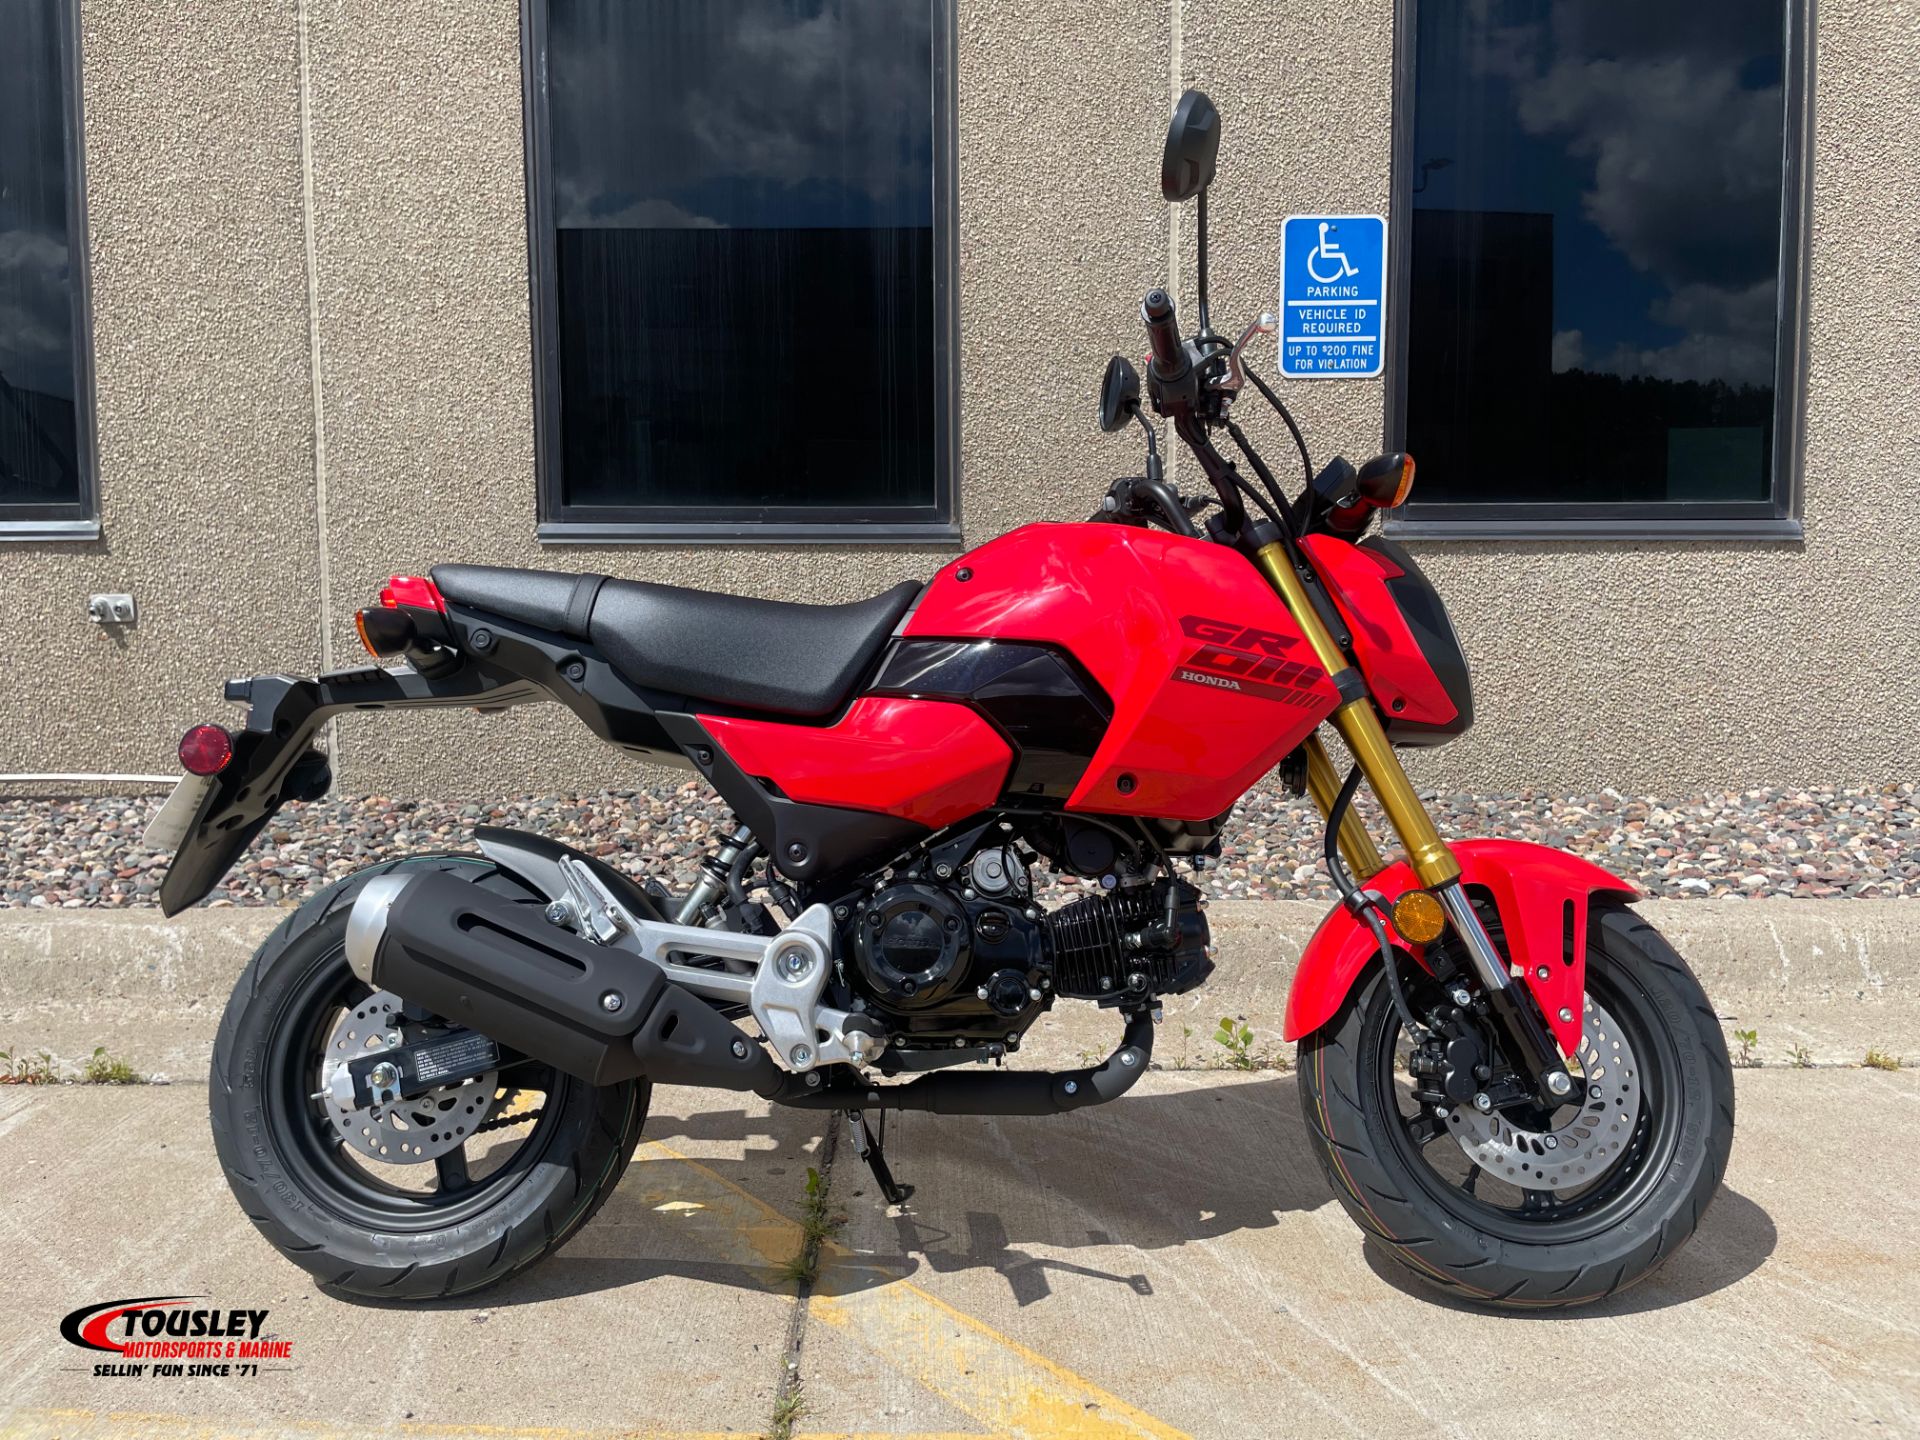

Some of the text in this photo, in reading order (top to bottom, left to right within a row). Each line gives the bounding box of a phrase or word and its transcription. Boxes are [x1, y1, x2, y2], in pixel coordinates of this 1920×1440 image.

[1307, 286, 1359, 297] PARKING
[1299, 309, 1366, 320] VEHICLE ID
[1303, 323, 1361, 333] REQUIRED
[1288, 345, 1374, 356] UP TO $200 FINE
[1295, 358, 1367, 369] FOR VIOLATION
[1180, 670, 1242, 690] HONDA
